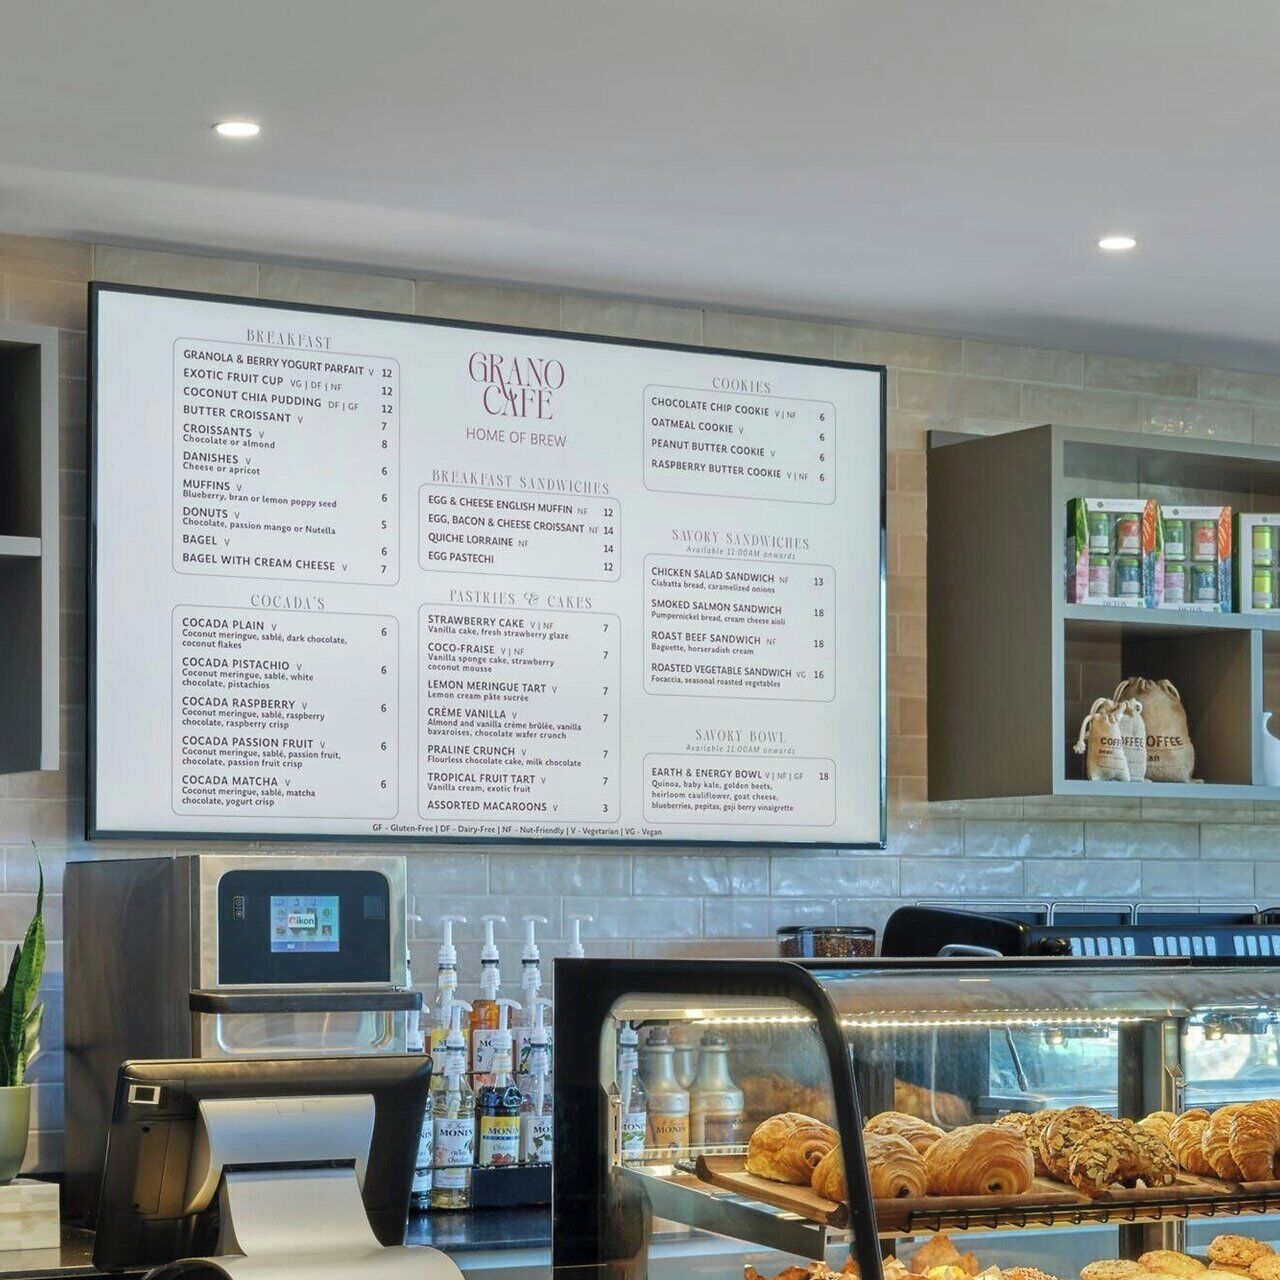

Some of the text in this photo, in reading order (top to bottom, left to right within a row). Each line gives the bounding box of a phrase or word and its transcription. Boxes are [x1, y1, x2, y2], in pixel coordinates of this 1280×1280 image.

[247, 328, 332, 350] BREAKFAST
[183, 349, 364, 374] GRANOLA & BERRY YOGURT PARFAIT
[183, 367, 283, 385] EXOTIC FRUIT CUP
[469, 352, 565, 392] GRANO
[712, 377, 771, 394] COOKIES
[183, 386, 321, 407] COCONUT CHIA PUDDING
[484, 384, 553, 420] CAFÉ
[183, 404, 291, 422] BUTTER CROISSANT
[651, 396, 769, 416] CHOCOLATE CHIP COOKIE
[182, 423, 252, 437] CROISSANTS
[651, 417, 733, 433] OATMEAL COOKIE
[182, 433, 228, 445] Chocolate
[242, 439, 275, 449] almond
[466, 427, 567, 447] HOME OF BREW
[651, 438, 765, 457] PEANUT BUTTER COOKIE
[183, 451, 238, 464] DANISHES
[651, 459, 781, 478] RASPBERRY BUTTER COOKIE
[182, 479, 230, 491] MUFFINS
[432, 470, 610, 495] BREAKFAST SANDWICHES
[428, 494, 572, 514] EGG & CHEESE ENGLISH MUFFIN
[182, 506, 228, 518] DONUTS
[452, 515, 485, 526] BACON
[487, 517, 494, 527] &
[496, 518, 531, 529] CHEESE
[533, 521, 585, 533] CROISSANT
[182, 534, 217, 545] BAGEL
[428, 532, 513, 546] QUICHE LORRAINE
[672, 529, 809, 549] SAVORY SANDWICHES
[182, 552, 335, 571] BAGEL WITH CREAM CHEESE
[428, 550, 494, 563] EGG PASTECHI
[651, 566, 774, 583] CHICKEN SALAD SANDWICH
[651, 578, 682, 588] Ciabatta
[683, 580, 706, 590] bread,
[707, 583, 750, 592] caramelized
[250, 593, 325, 611] COCADA'S
[450, 590, 592, 609] PASTRIES & CAKES
[651, 598, 782, 614] SMOKED SALMON SANDWICH
[182, 617, 264, 630] COCADA PLAIN
[428, 614, 524, 628] STRAWBERRY CAKE
[651, 630, 761, 644] ROAST BEEF SANDWICH
[427, 642, 494, 654] COCO-FRAISE
[182, 656, 290, 670] COCADA PISTACHIO
[651, 662, 792, 677] ROASTED VEGETABLE SANDWICH
[427, 679, 546, 693] LEMON MERINGUE TART
[182, 696, 295, 709] COCADA RASPBERRY
[464, 708, 506, 719] VANILLA
[182, 735, 314, 748] COCADA PASSION FRUIT
[695, 729, 786, 743] SAVORY BOWL
[427, 744, 515, 757] PRALINE CRUNCH
[181, 774, 278, 786] COCADA MATCHA
[427, 772, 535, 784] TROPICAL FRUIT TART
[651, 767, 762, 779] EARTH & ENERGY BOWL
[427, 800, 547, 811] ASSORTED MACAROONS
[372, 824, 383, 832] GF
[390, 824, 434, 832] Gluten-Free
[458, 826, 496, 834] Dairy-Free
[520, 826, 564, 836] Nut-Friendly
[582, 828, 619, 837] Vegetarian
[625, 828, 636, 836] VG
[642, 828, 662, 837] Vegan
